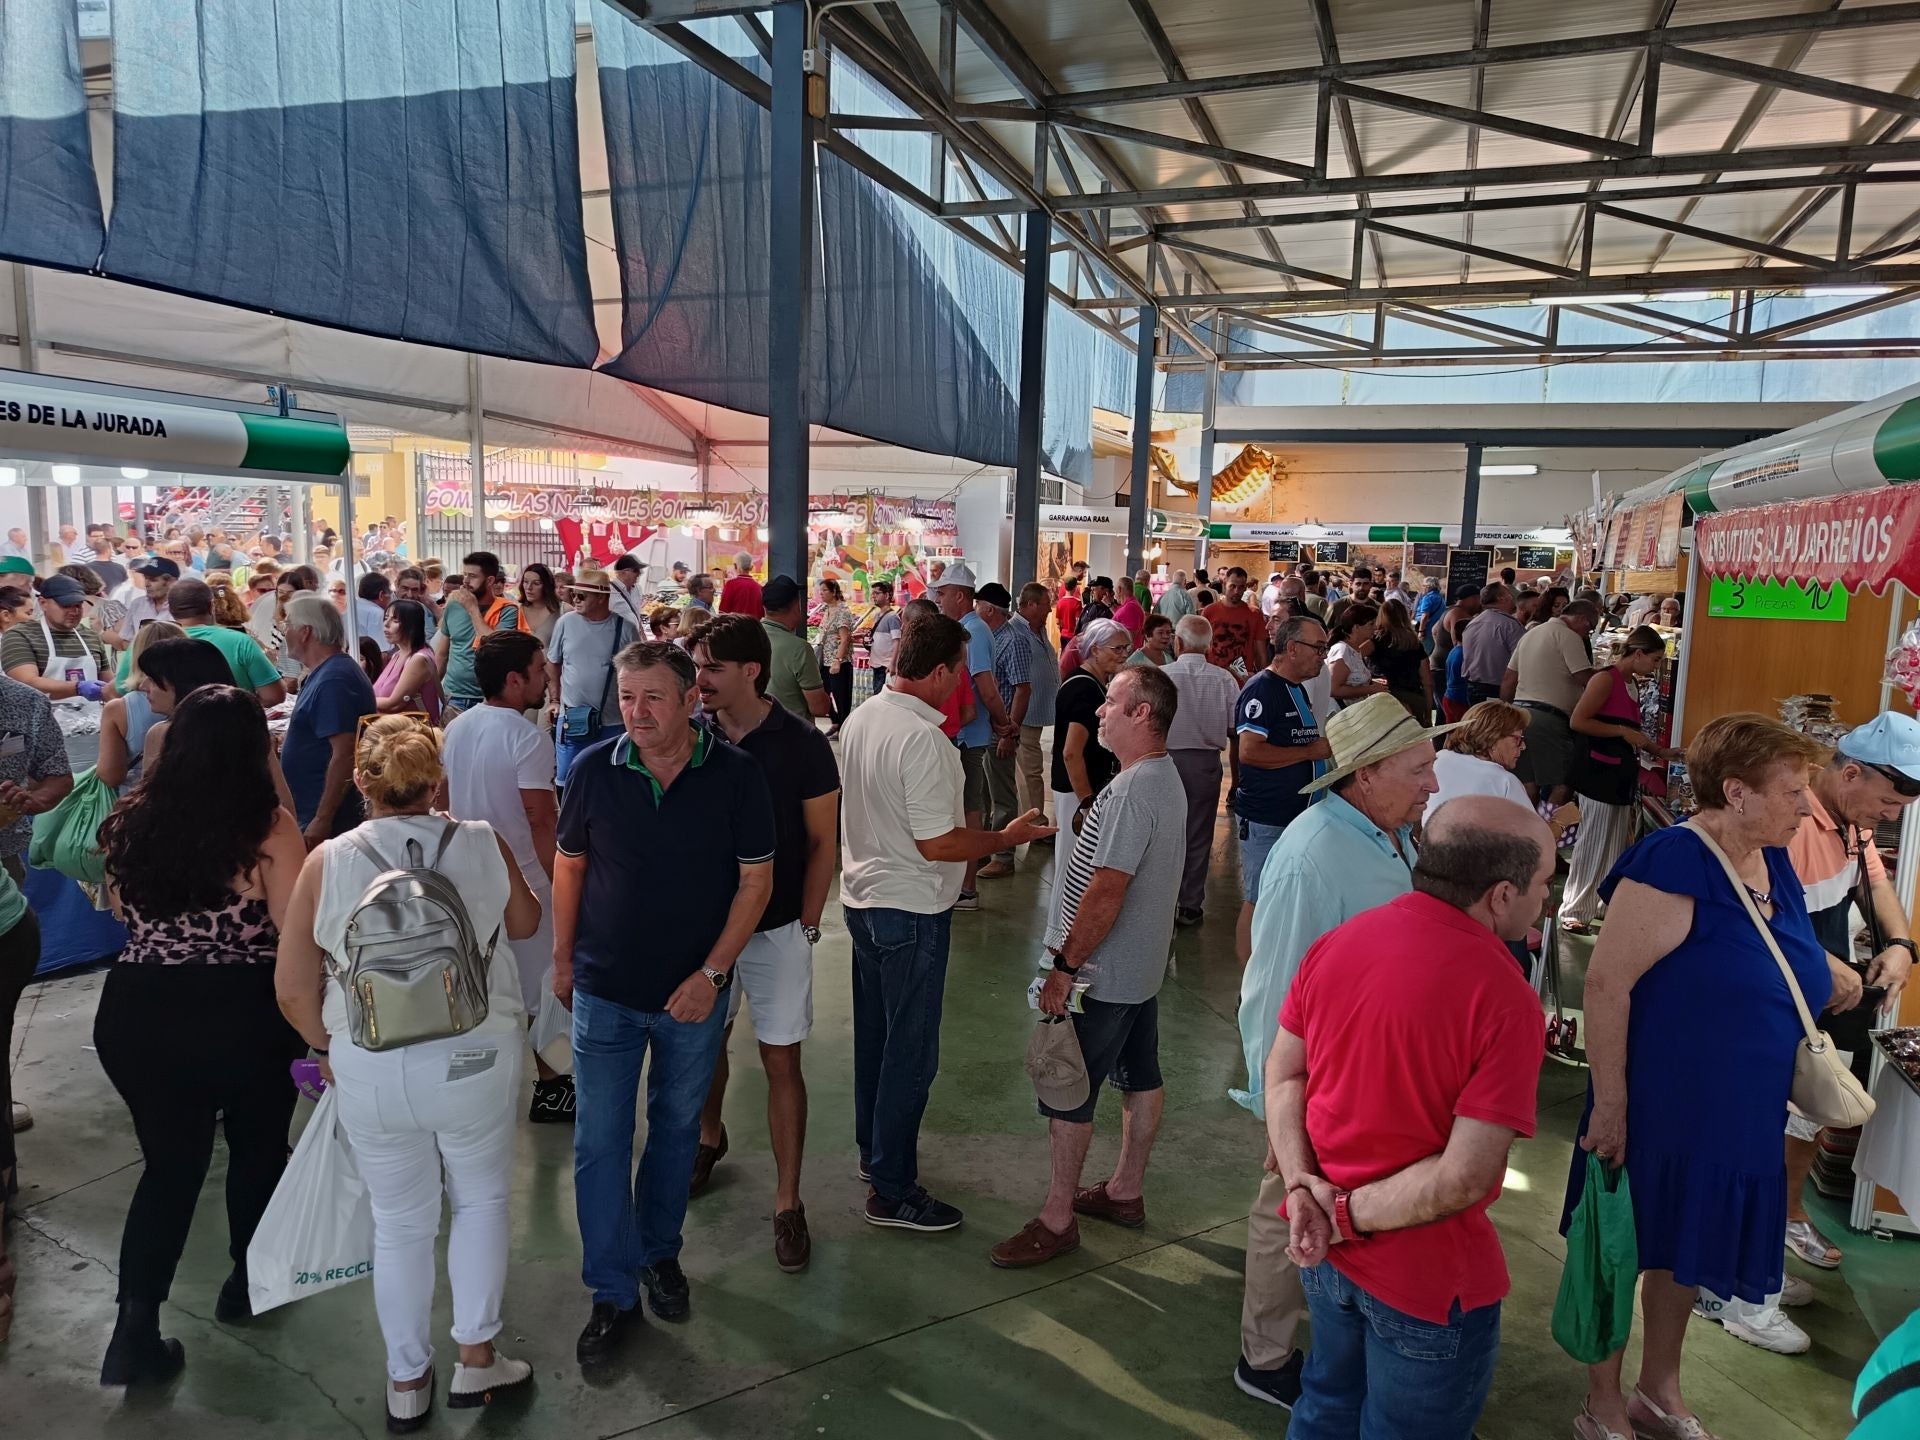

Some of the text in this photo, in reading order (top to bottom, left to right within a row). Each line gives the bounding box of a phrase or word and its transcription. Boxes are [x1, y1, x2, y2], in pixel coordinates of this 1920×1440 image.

[27, 403, 55, 426] DE
[61, 407, 87, 429] LA
[92, 411, 168, 438] JURADA
[1048, 514, 1111, 524] GARRAPINADA RASA
[1730, 582, 1745, 610] 3
